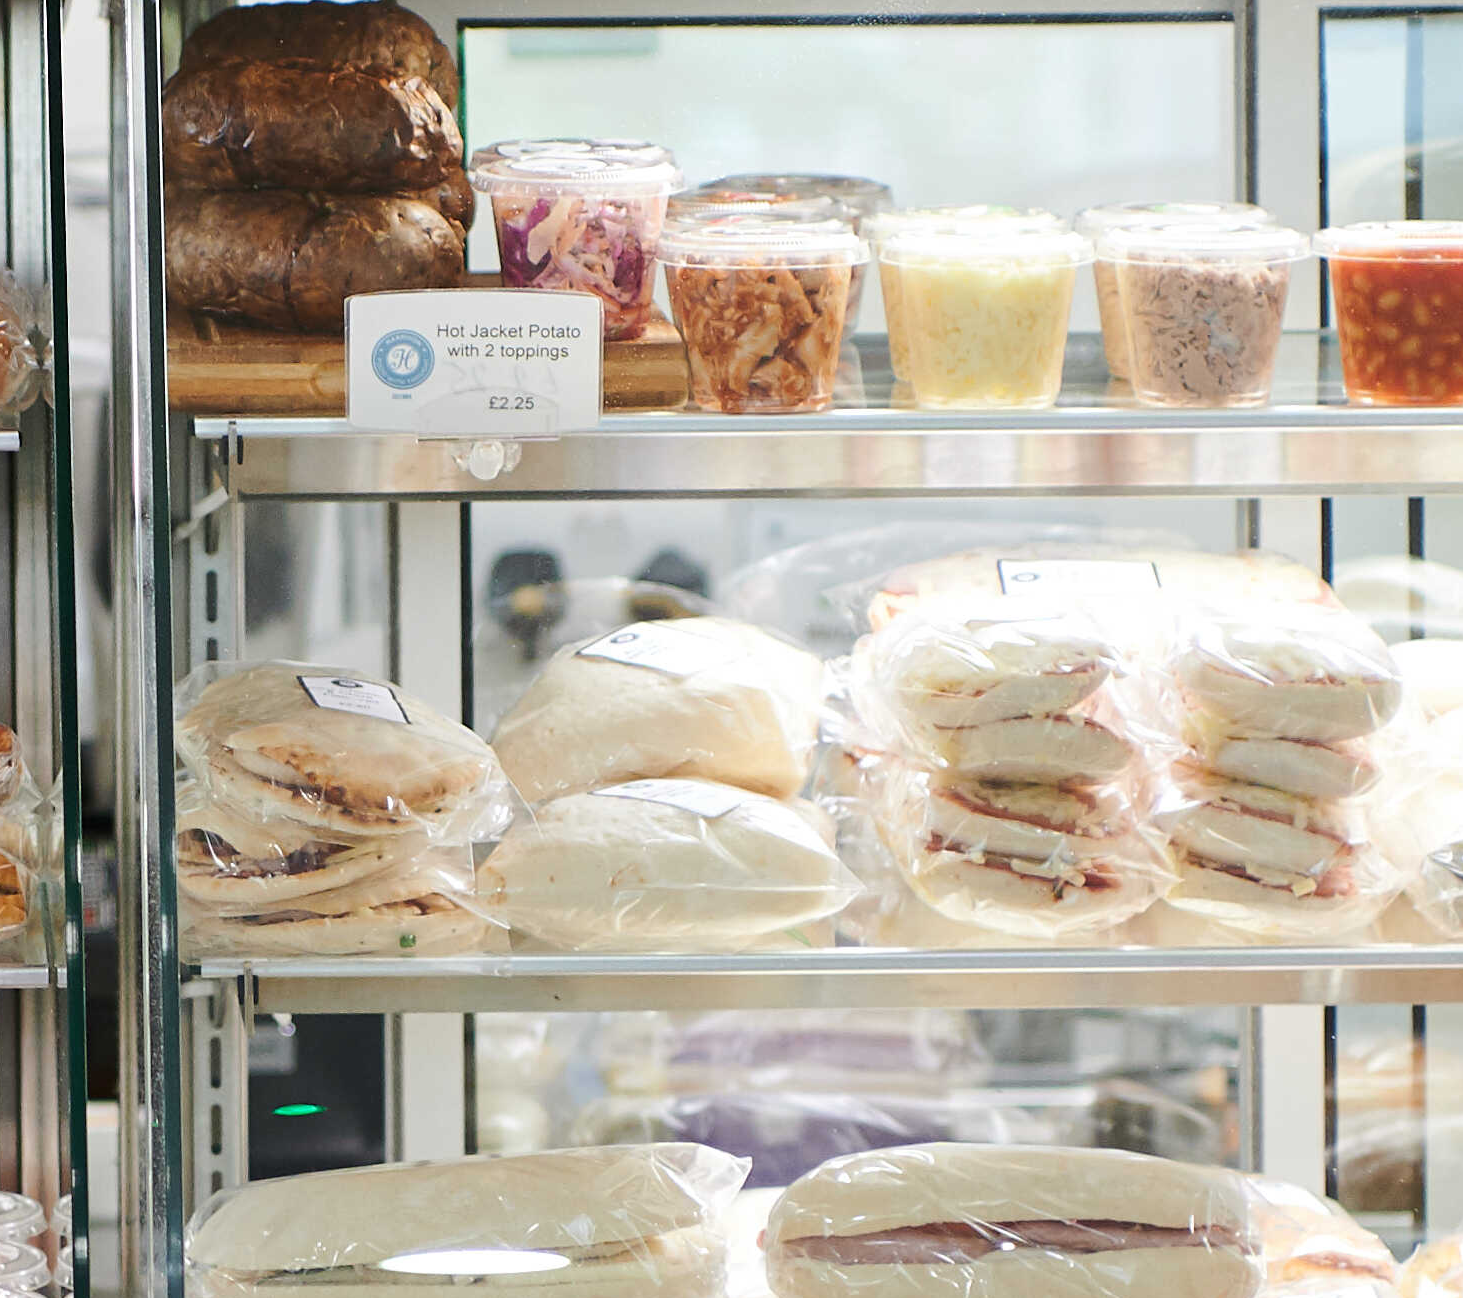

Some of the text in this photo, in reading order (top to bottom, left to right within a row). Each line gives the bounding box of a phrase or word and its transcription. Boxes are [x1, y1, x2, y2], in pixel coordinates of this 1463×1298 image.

[437, 324, 580, 338] Hot Jacket Potato
[448, 344, 569, 361] with 2 toppings
[489, 396, 534, 410] £2.25
